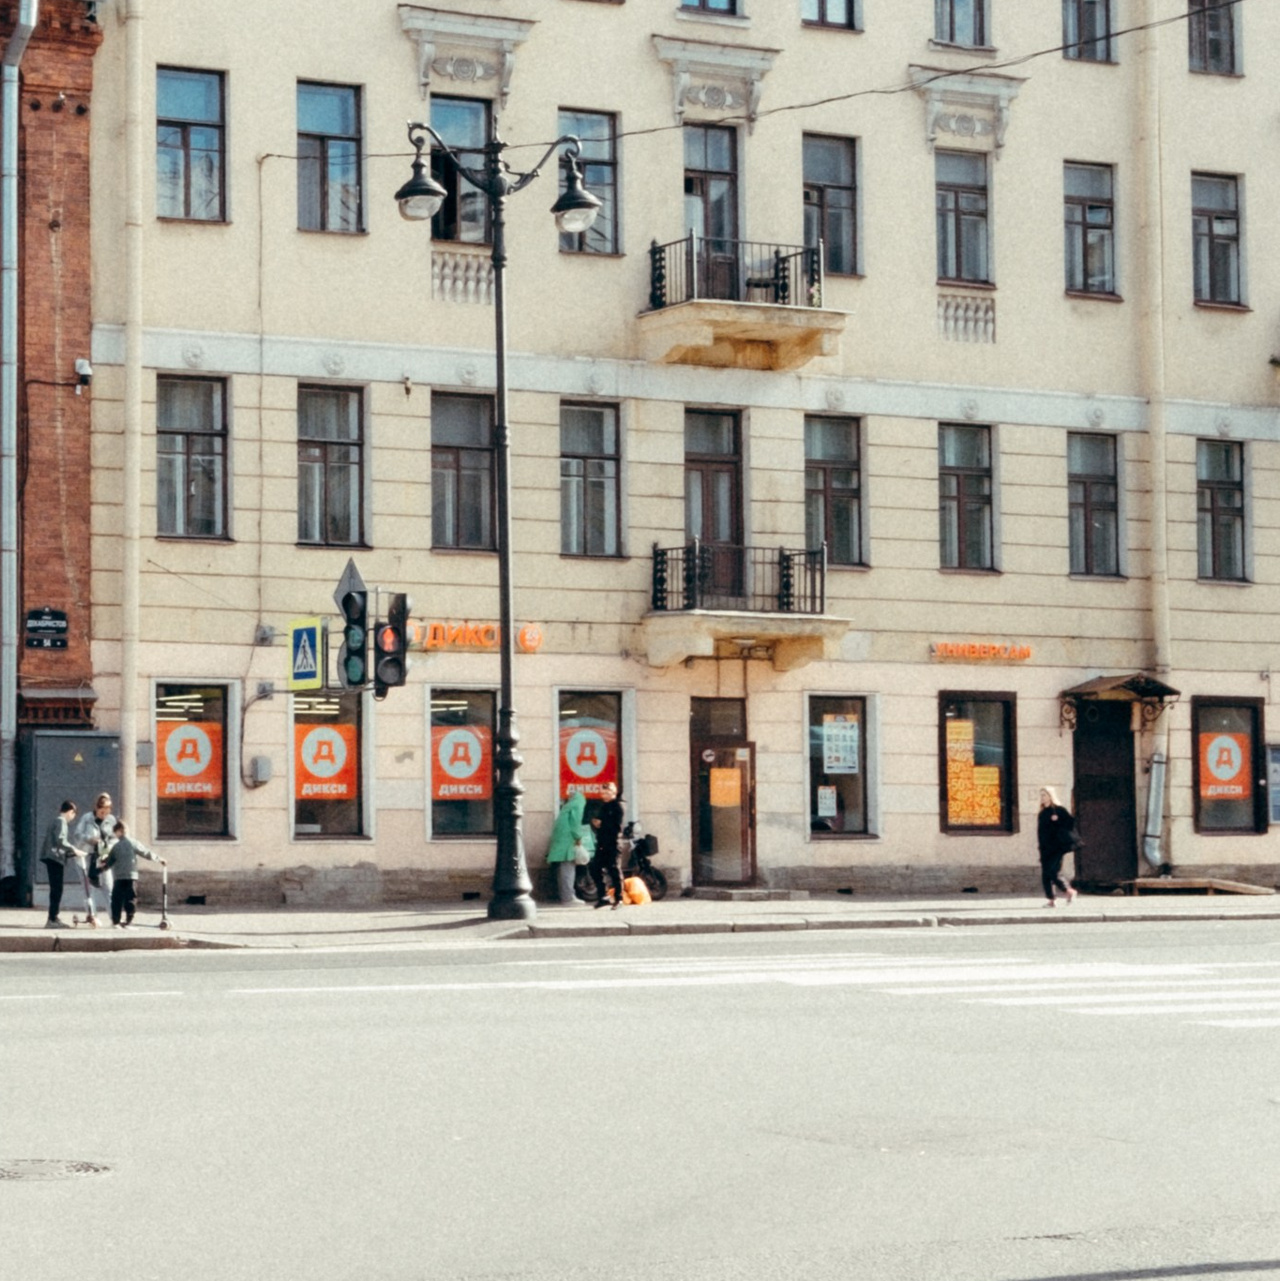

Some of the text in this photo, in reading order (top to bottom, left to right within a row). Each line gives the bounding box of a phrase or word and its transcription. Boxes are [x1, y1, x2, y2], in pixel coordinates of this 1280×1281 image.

[426, 623, 500, 648] ДИКС
[935, 642, 1031, 659] УНИВЕРСАМ
[165, 782, 212, 795] ДИКСИ
[301, 783, 347, 796] ДИКСИ
[439, 784, 483, 796] ДИКСИ
[1207, 785, 1243, 796] ДИКСИ
